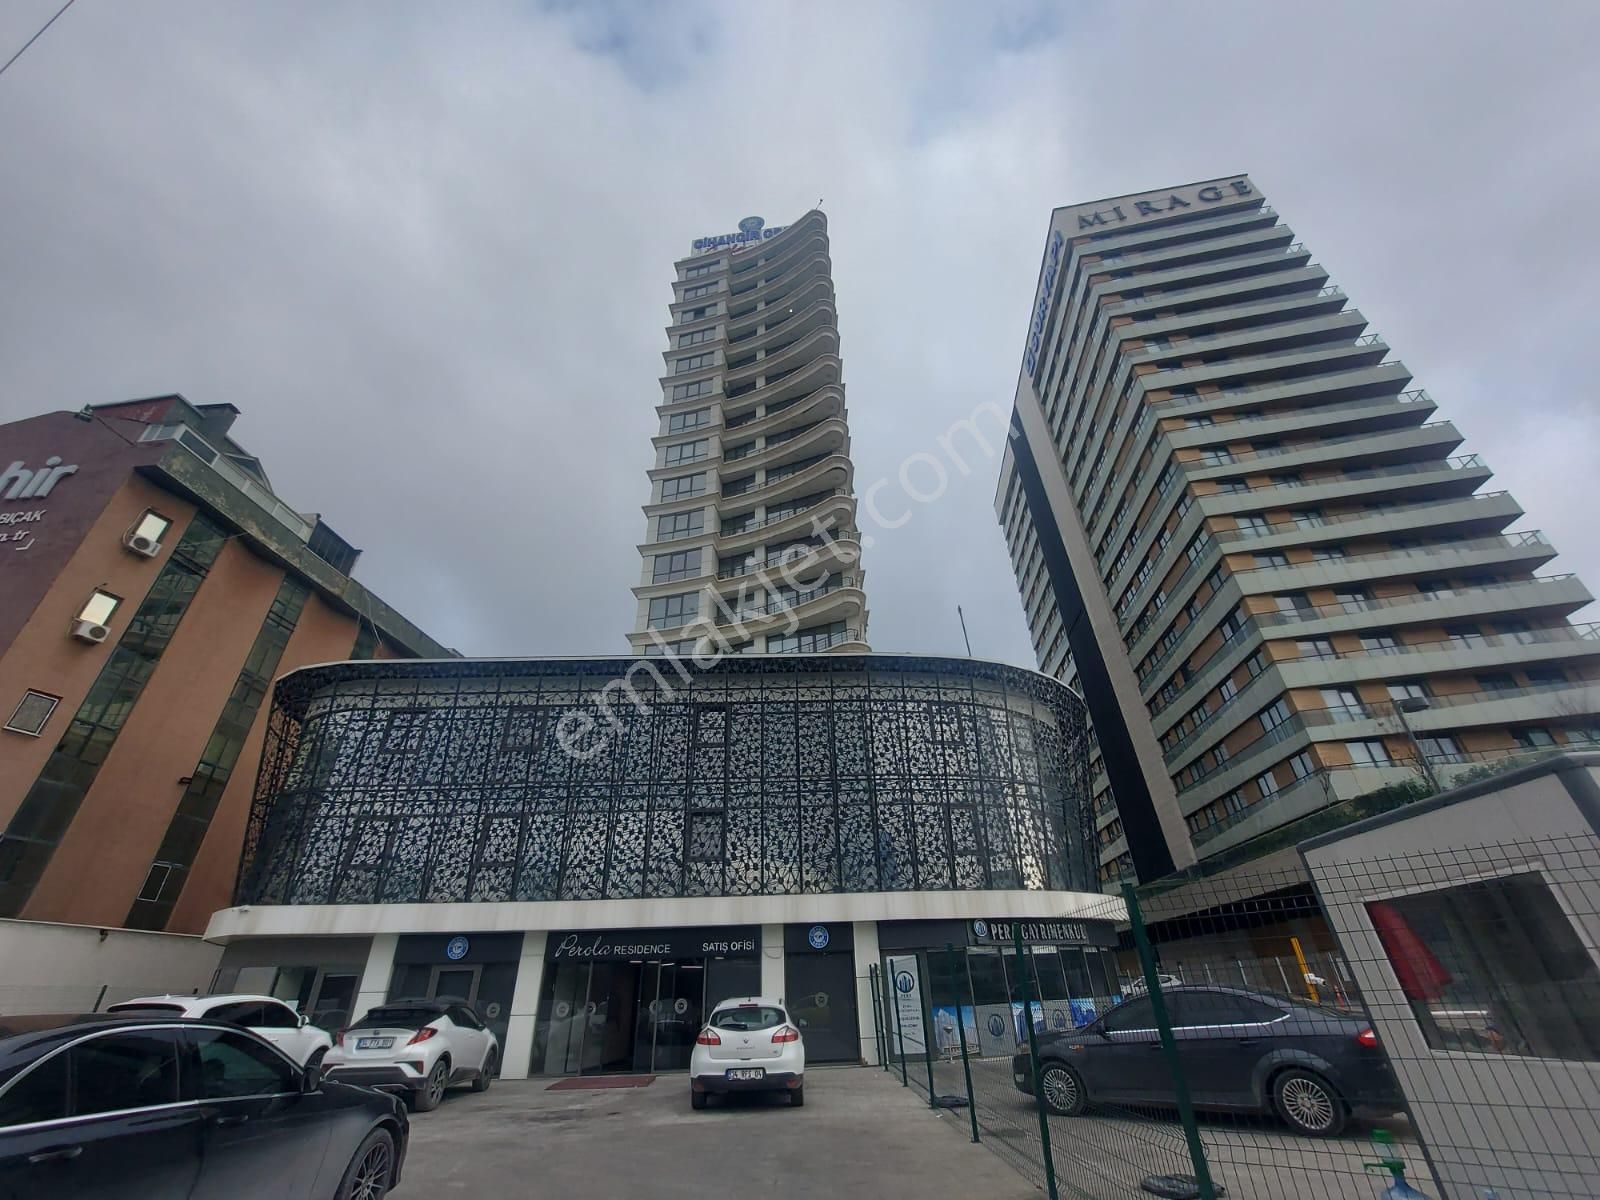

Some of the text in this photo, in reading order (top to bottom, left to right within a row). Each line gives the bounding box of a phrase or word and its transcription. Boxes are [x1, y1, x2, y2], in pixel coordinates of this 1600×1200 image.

[1079, 180, 1251, 229] MIRAGE
[991, 923, 1016, 940] PER
[613, 944, 671, 955] RESIDENCE
